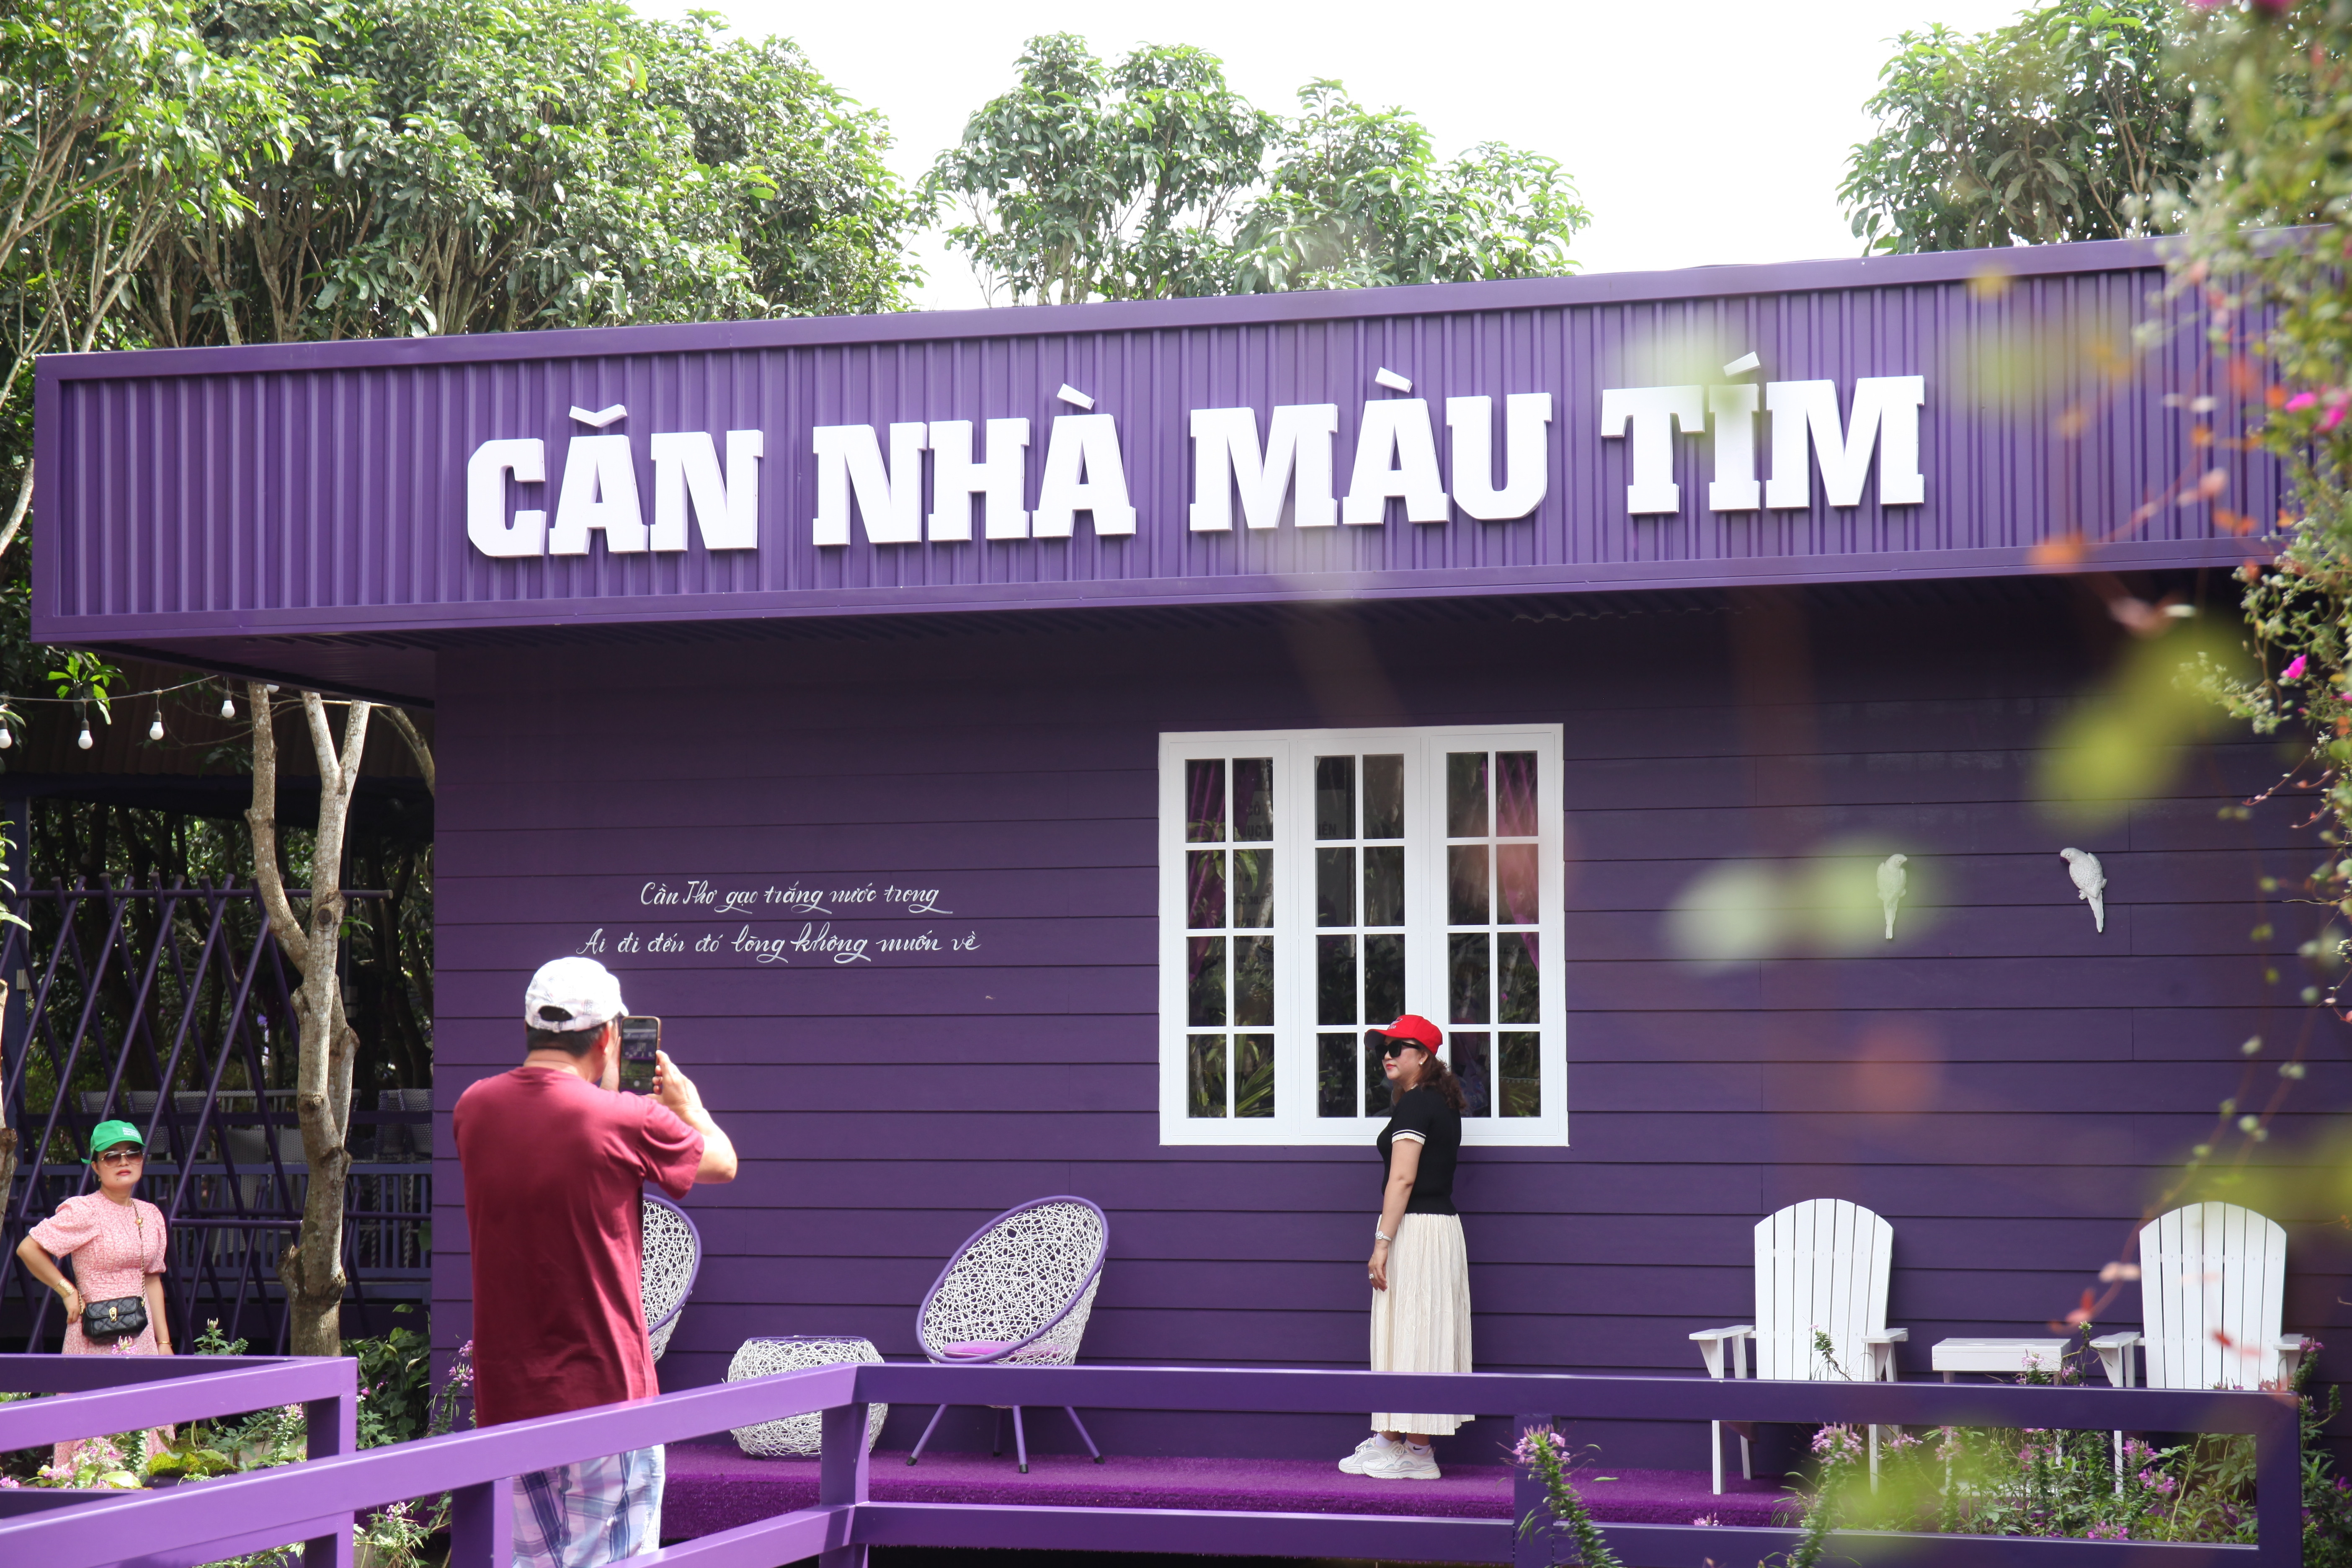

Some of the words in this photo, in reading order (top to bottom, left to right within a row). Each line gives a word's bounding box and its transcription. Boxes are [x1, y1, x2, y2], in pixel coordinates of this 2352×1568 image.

[466, 403, 766, 558] CĂN
[812, 383, 1137, 546] NHÀ
[1189, 366, 1554, 533] MÀU
[1601, 351, 1926, 515] TÍM
[641, 882, 680, 905] Cần
[682, 880, 717, 905] Thơ
[714, 890, 758, 914] gạo
[764, 880, 832, 915] trắng
[829, 882, 877, 903] nước
[884, 885, 953, 914] trong
[576, 928, 607, 954] Ai
[618, 932, 641, 953] đi
[647, 932, 686, 952] đến
[695, 934, 723, 952] đó
[731, 924, 789, 964] lòng
[790, 921, 871, 964] không
[876, 930, 943, 952] muốn
[951, 931, 981, 951] về
